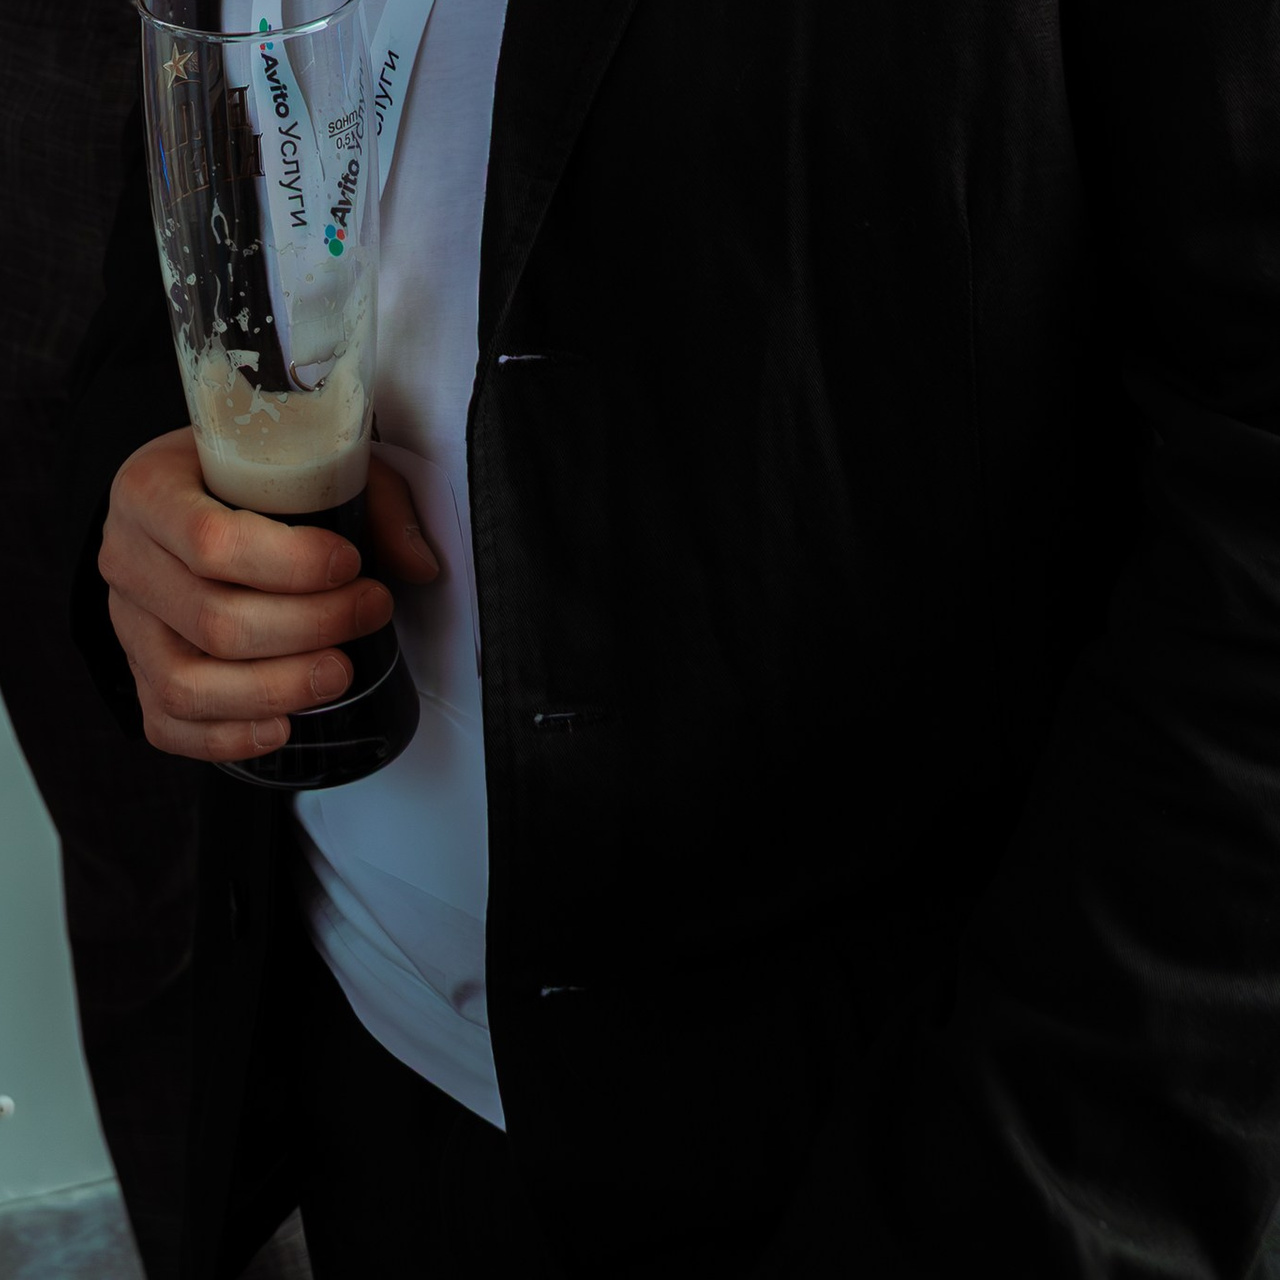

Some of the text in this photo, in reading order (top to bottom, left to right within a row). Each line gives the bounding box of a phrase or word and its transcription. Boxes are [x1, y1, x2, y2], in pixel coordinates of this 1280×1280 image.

[260, 51, 308, 229] Avito Услуги
[330, 158, 361, 229] Avito
